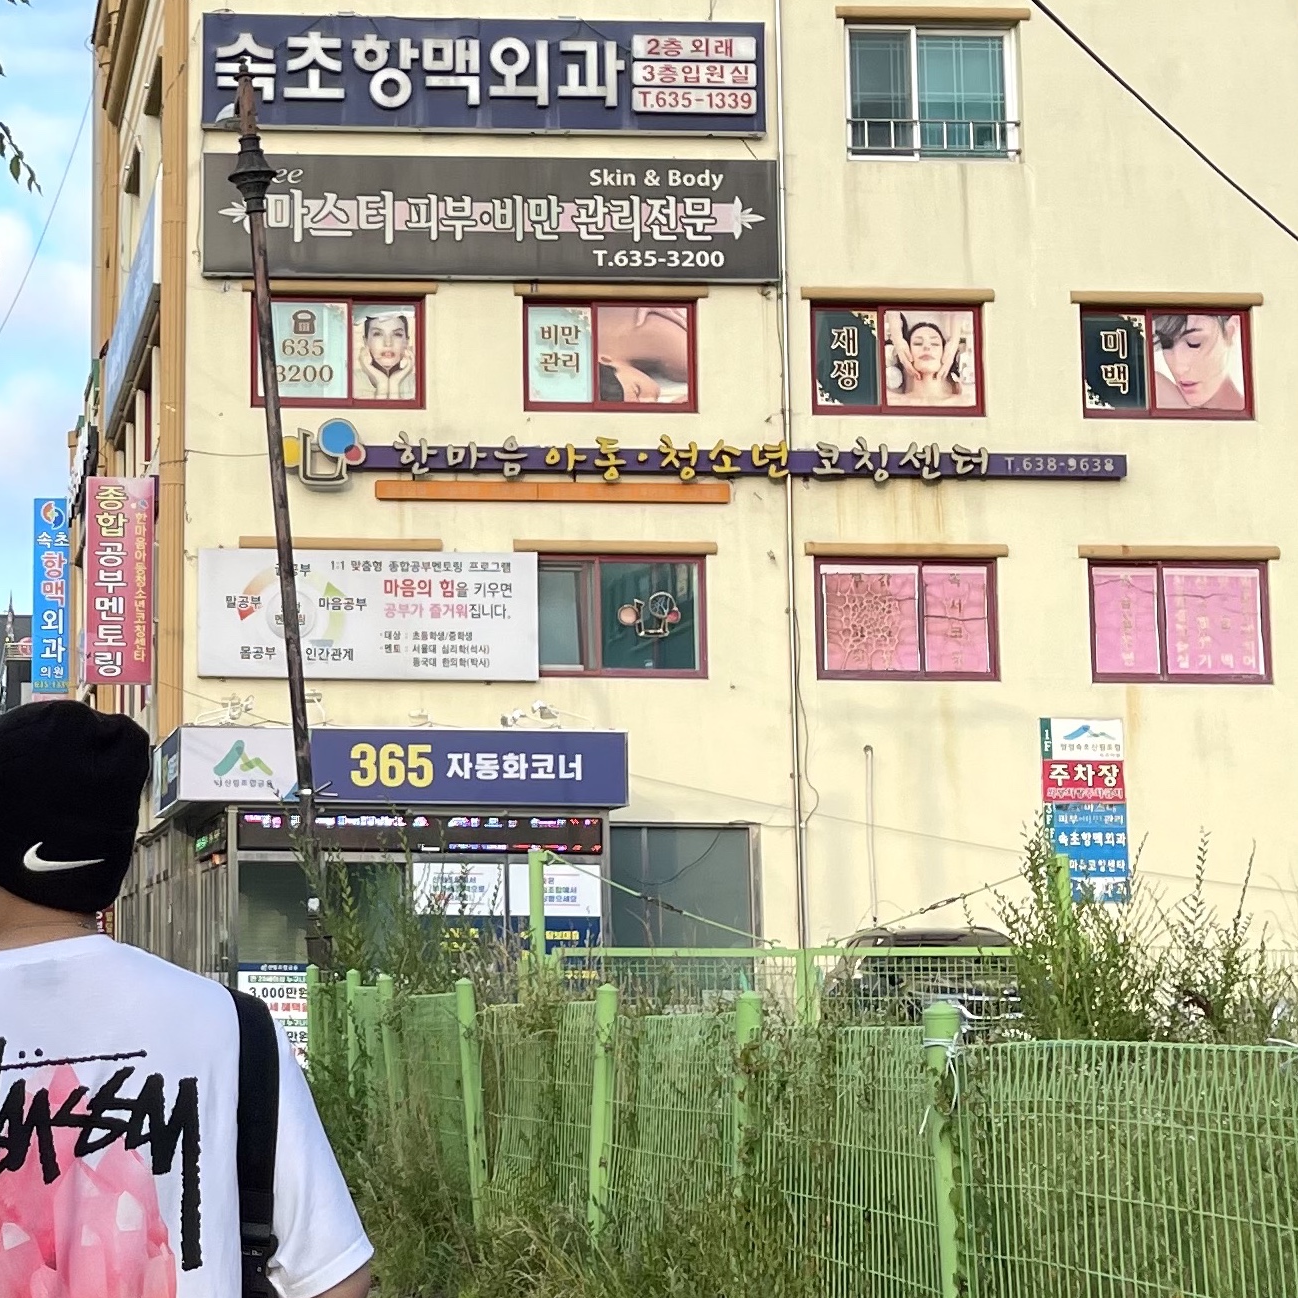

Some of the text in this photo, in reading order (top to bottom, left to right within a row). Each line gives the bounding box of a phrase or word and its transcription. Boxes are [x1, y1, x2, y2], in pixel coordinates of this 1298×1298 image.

[646, 38, 734, 57] 2층 외래
[214, 31, 626, 109] 속초항맥외과
[637, 90, 753, 109] T.635-1339
[588, 168, 724, 191] Skin & Body
[264, 188, 395, 245] 마스터
[571, 194, 718, 243] 관리전문
[592, 250, 725, 268] T.635-3200
[539, 323, 582, 348] 비만
[280, 337, 326, 358] 635
[539, 352, 582, 376] 관리
[829, 326, 860, 392] 재생
[1099, 327, 1131, 395] 미백
[273, 364, 335, 384] 3200
[392, 430, 530, 479] 한마음
[814, 436, 991, 483] 코칭센터
[36, 531, 70, 549] 속초
[330, 560, 345, 571] 1:1
[350, 560, 383, 572] 맞춤형
[468, 561, 512, 574] 프로그램
[383, 579, 513, 599] 마음의 힘을 키우면
[225, 595, 262, 609] 말공부
[318, 597, 368, 612] 마음공부
[384, 603, 512, 620] 공부가 즐거워집니다.
[239, 646, 277, 660] 몸공부
[305, 647, 354, 661] 인간관계
[412, 644, 438, 655] 서울대
[39, 665, 64, 679] 의원
[350, 743, 584, 788] 365 자동화코너
[1048, 763, 1120, 787] 주차장
[1058, 831, 1127, 847] 속초항맥외과
